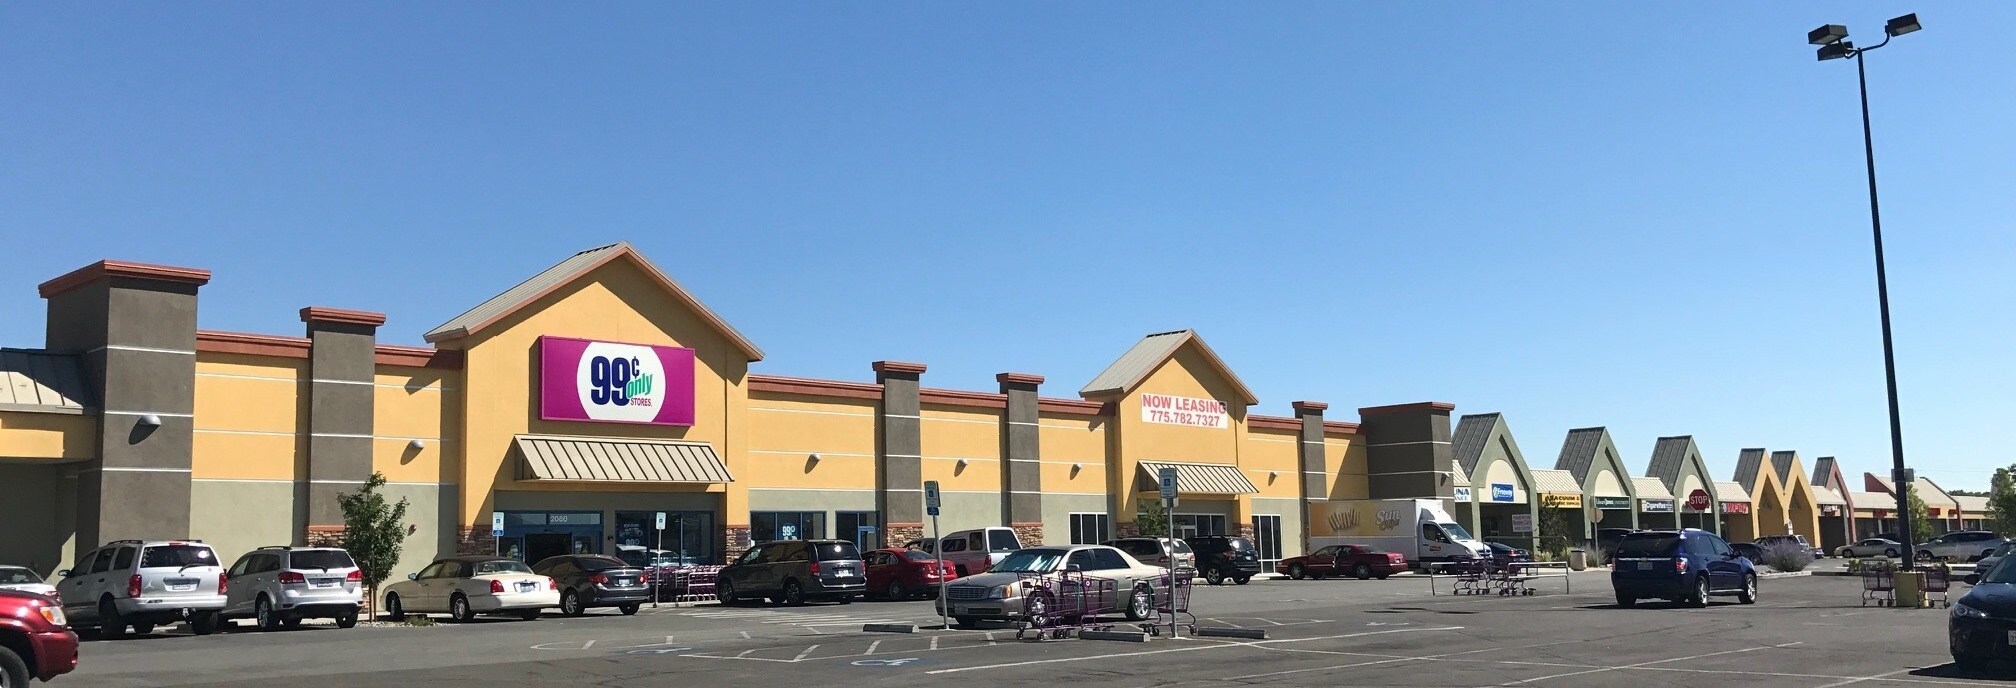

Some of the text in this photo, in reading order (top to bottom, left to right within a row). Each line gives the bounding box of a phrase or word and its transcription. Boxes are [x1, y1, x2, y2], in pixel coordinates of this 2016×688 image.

[590, 355, 640, 406] 99¢
[626, 373, 653, 399] only
[1142, 394, 1227, 415] NOW LEASING
[1150, 410, 1220, 427] 775.782.7327
[1690, 495, 1708, 505] STOP
